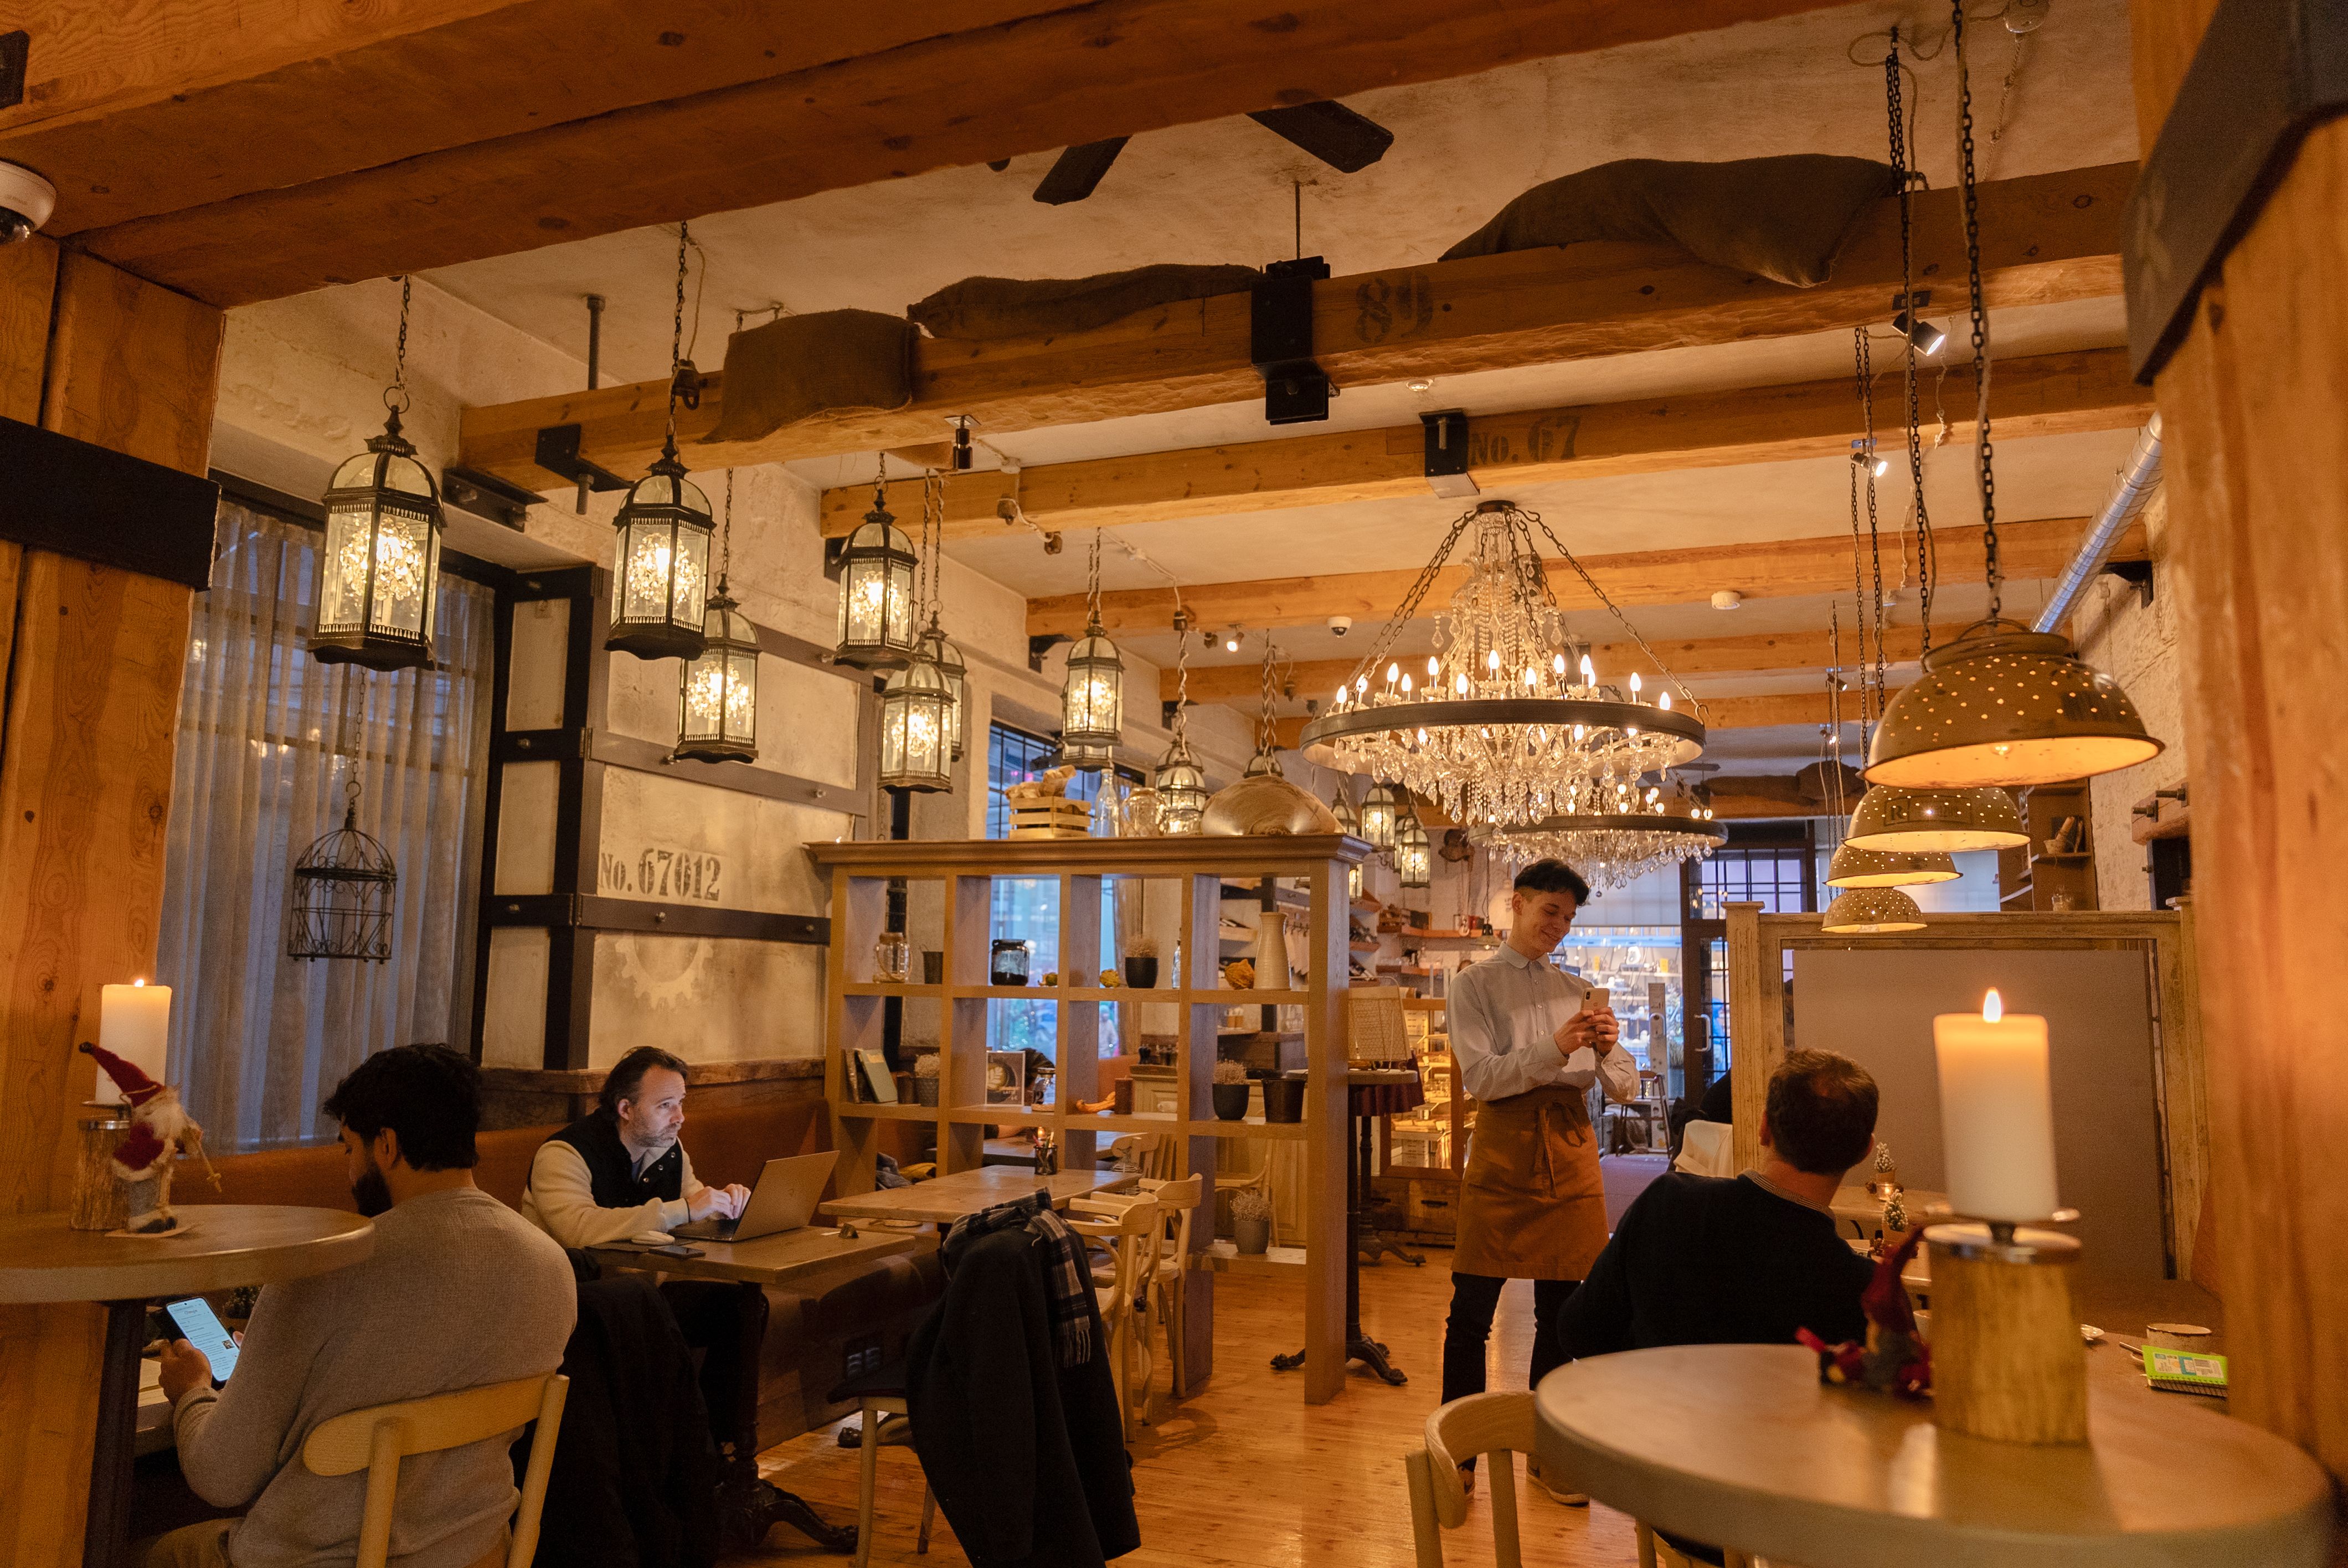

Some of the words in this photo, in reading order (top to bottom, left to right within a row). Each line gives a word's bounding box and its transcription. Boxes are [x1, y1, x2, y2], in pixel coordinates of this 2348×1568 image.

[1470, 432, 1519, 466] No.
[1527, 415, 1581, 462] 67
[599, 852, 632, 892] No.
[638, 848, 721, 901] 67012
